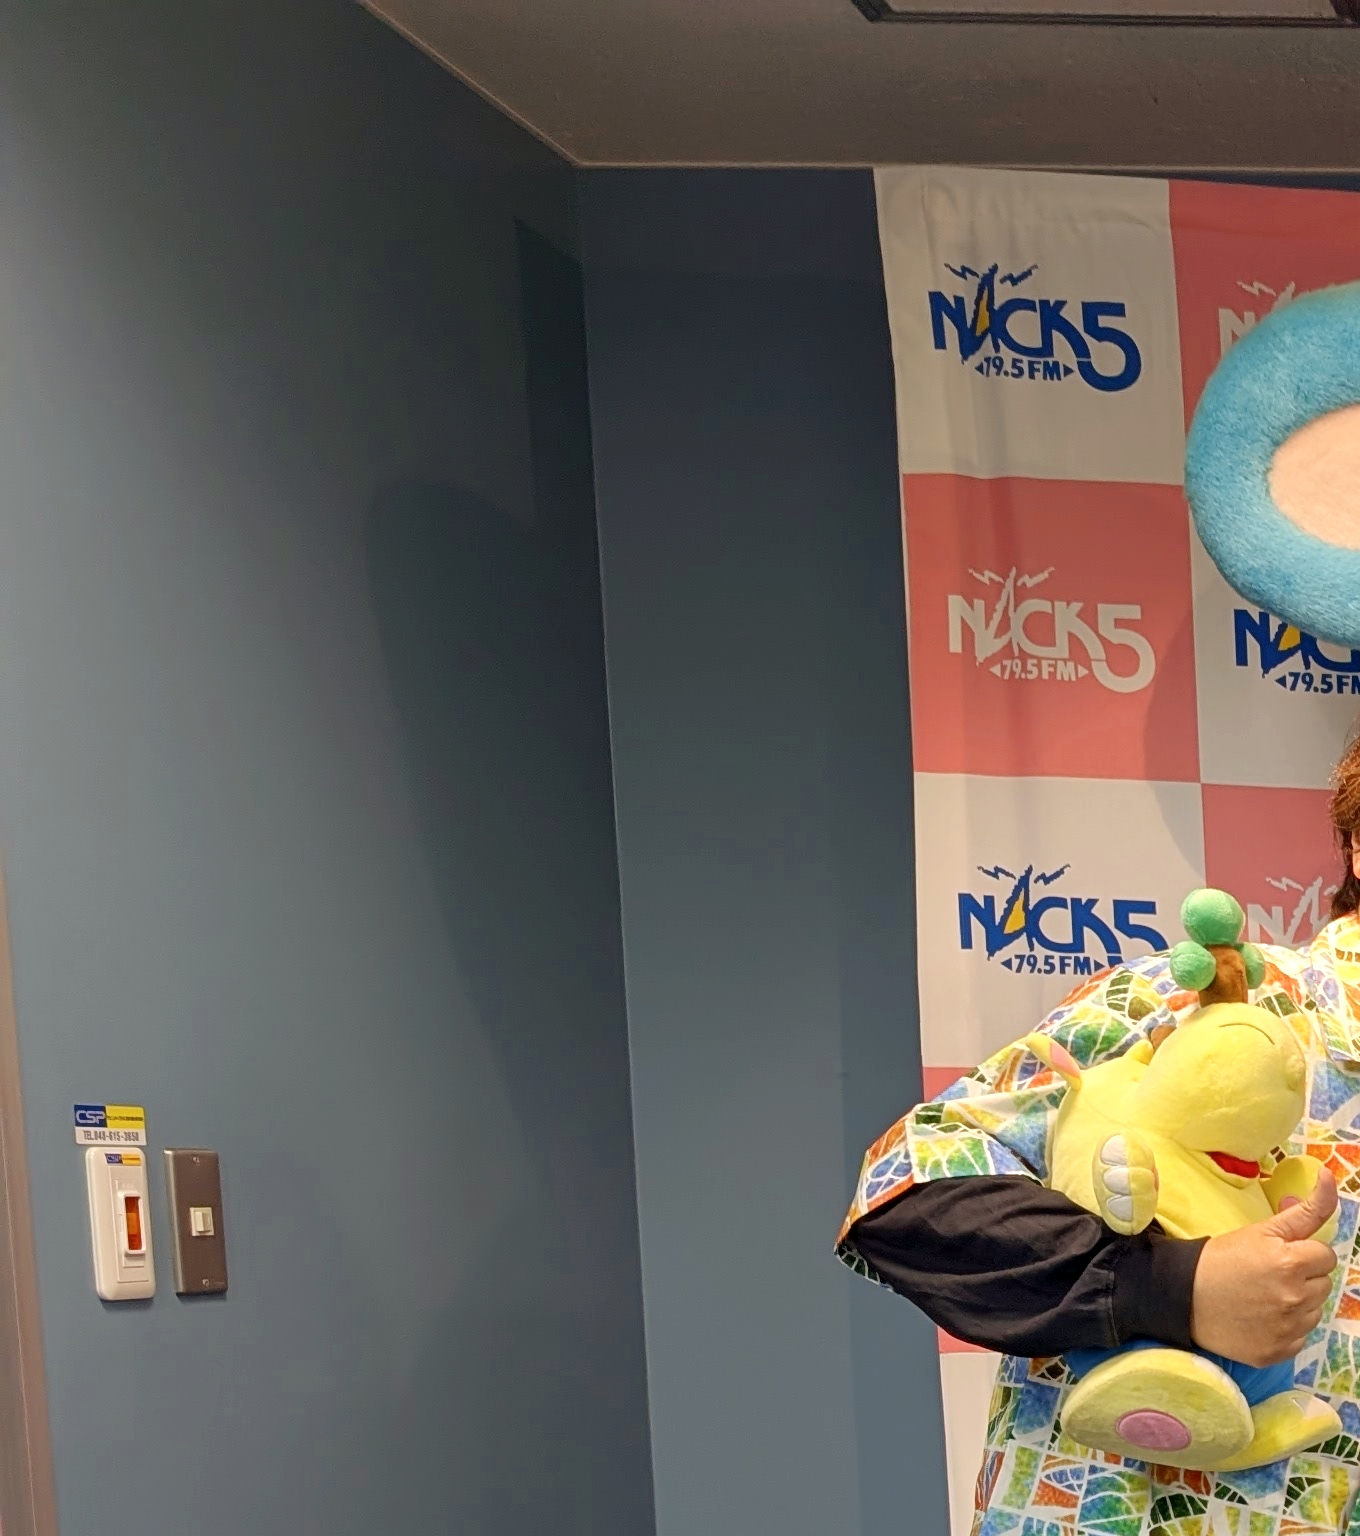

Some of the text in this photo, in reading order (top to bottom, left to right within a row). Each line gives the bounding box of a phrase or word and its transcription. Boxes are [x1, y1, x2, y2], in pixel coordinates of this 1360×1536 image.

[928, 263, 1142, 392] NACK5
[948, 566, 1156, 694] NACK5
[76, 1109, 106, 1125] CSP
